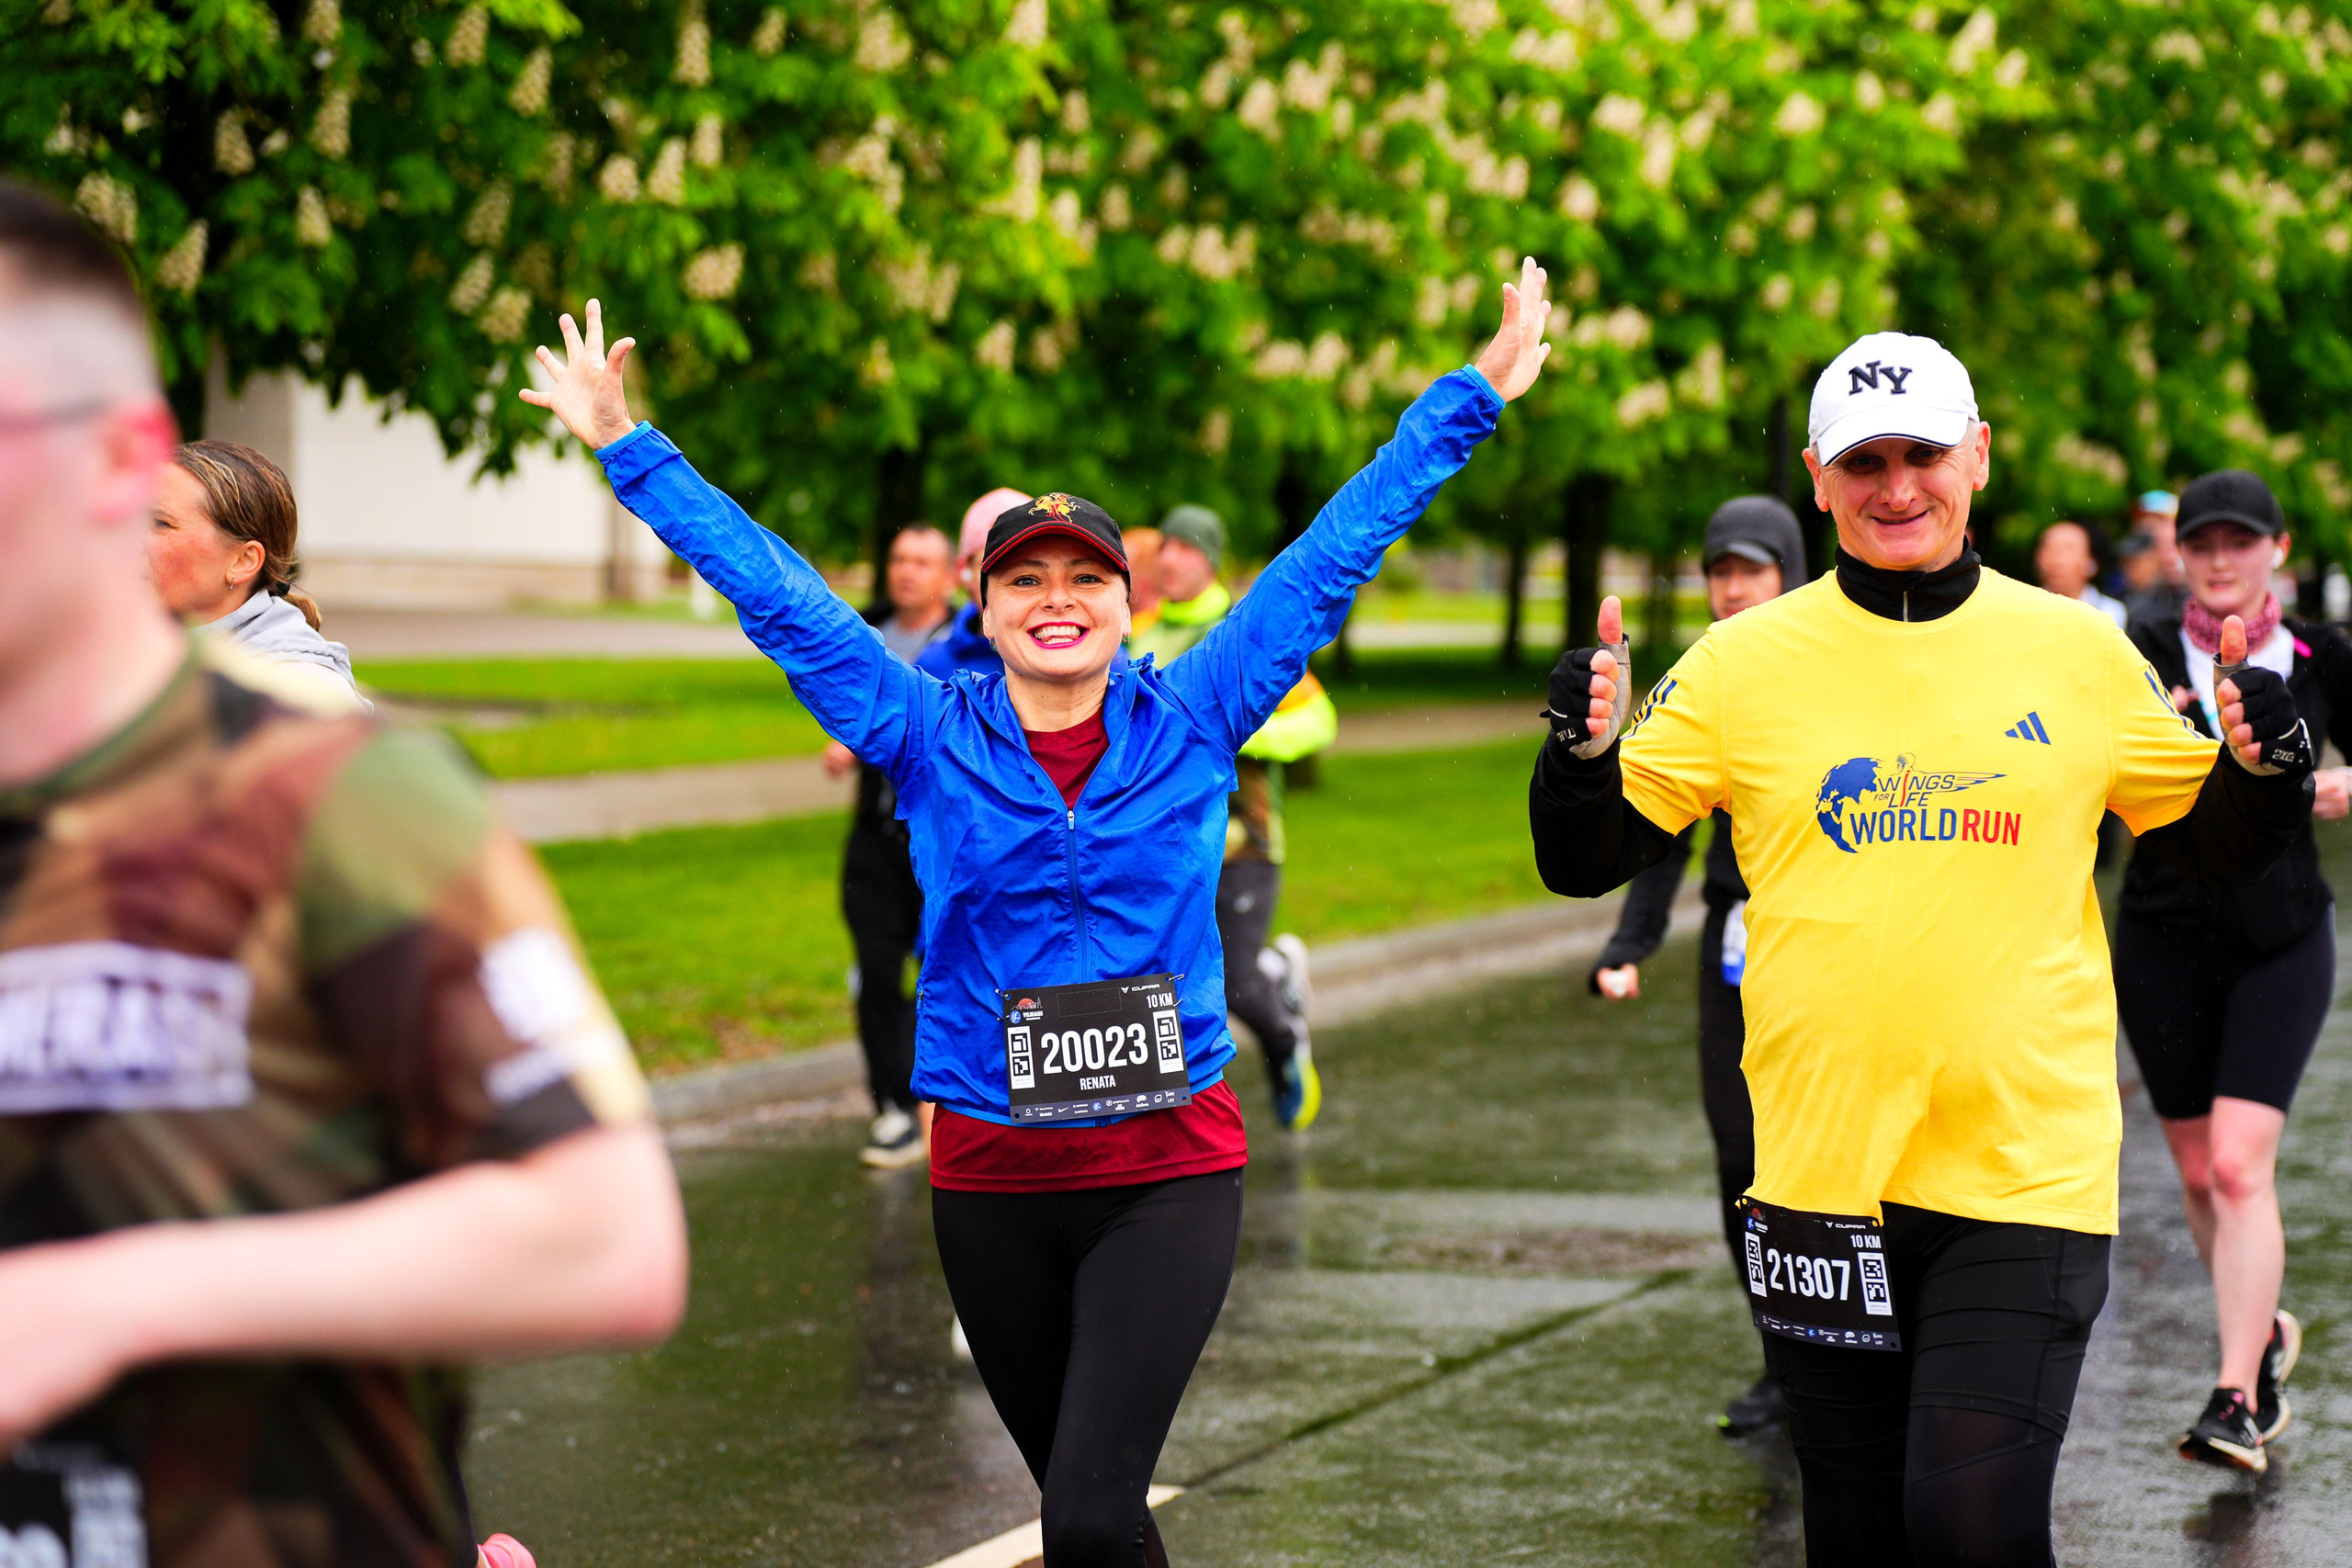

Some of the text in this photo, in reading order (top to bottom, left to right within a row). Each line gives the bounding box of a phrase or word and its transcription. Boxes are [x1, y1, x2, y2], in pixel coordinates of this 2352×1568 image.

[1849, 359, 1913, 396] NY
[1849, 808, 2021, 846] WORLD RUN
[1147, 992, 1173, 1009] 10 KM
[1040, 1022, 1148, 1075] 20023
[1080, 1075, 1116, 1090] RENATA
[1849, 1235, 1882, 1249] 10 KM
[1767, 1247, 1850, 1302] 21307
